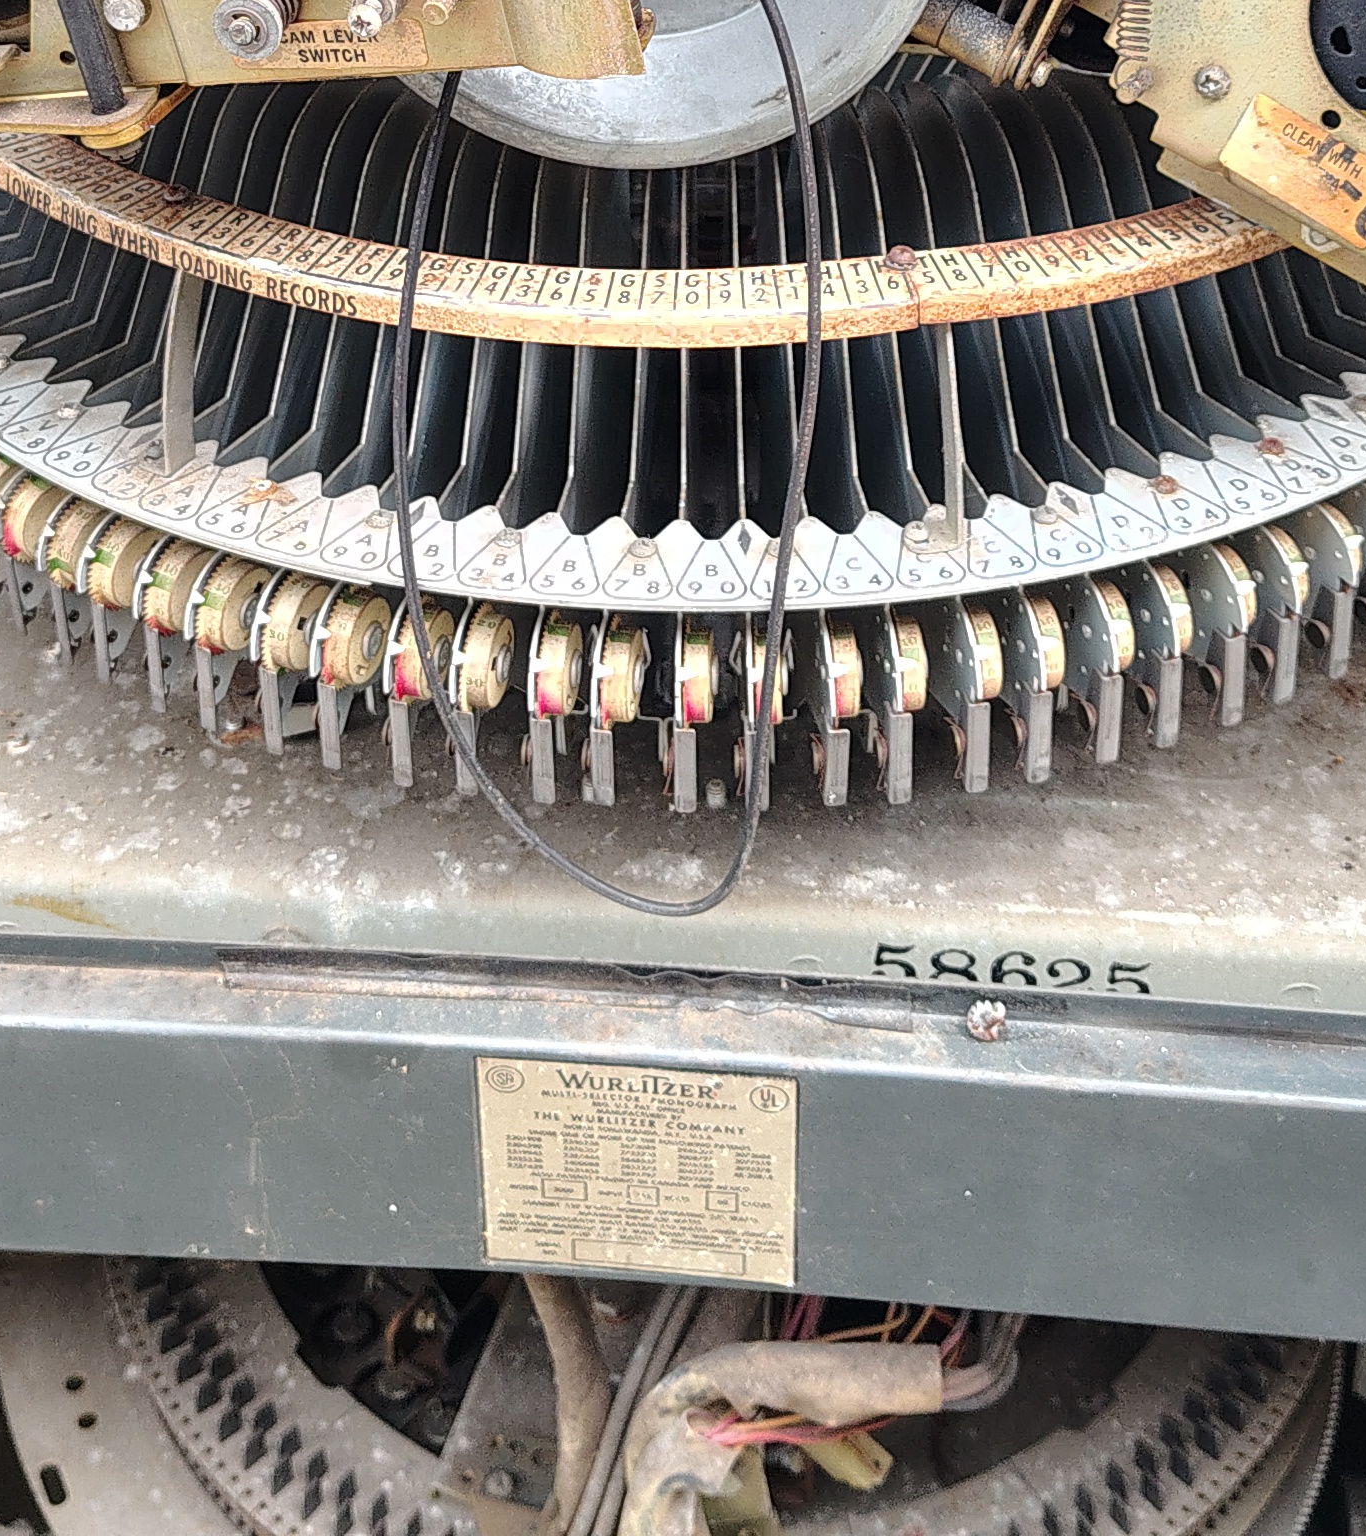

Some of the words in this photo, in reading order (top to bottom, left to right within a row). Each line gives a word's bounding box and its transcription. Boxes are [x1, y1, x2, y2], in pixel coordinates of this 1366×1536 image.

[298, 49, 366, 62] SWITCH
[1282, 123, 1326, 154] CLEAN
[1328, 149, 1363, 179] WITH
[6, 174, 52, 215] LOWER
[61, 201, 98, 236] RING
[109, 221, 160, 261] WHEN
[171, 246, 252, 291] LOADING
[266, 276, 358, 316] RECORDS
[232, 212, 249, 225] R
[338, 242, 356, 255] R
[492, 266, 507, 278] G
[524, 269, 536, 280] S
[555, 271, 571, 284] G
[620, 274, 635, 287] G
[655, 274, 665, 287] S
[685, 274, 700, 287] G
[719, 274, 730, 286] S
[751, 273, 765, 285] H
[786, 270, 796, 283] T
[850, 264, 861, 276] T
[940, 254, 958, 266] H
[213, 228, 230, 239] 3
[240, 236, 255, 246] 6
[268, 243, 286, 254] 5
[297, 250, 314, 262] 8
[389, 269, 404, 281] 9
[486, 281, 497, 294] 4
[515, 285, 530, 297] 3
[551, 288, 562, 300] 6
[618, 291, 630, 303] 8
[652, 291, 664, 304] 7
[720, 290, 731, 303] 9
[755, 289, 766, 301] 2
[824, 284, 835, 296] 4
[858, 281, 869, 293] 3
[888, 276, 899, 290] 6
[923, 272, 935, 283] 5
[953, 269, 968, 281] 8
[982, 265, 993, 277] 7
[1046, 255, 1059, 267] 9
[1164, 229, 1182, 240] 3
[1192, 222, 1209, 233] 6
[562, 560, 576, 572] B
[705, 565, 719, 577] B
[646, 581, 660, 594] 8
[688, 582, 703, 595] 9
[908, 569, 922, 582] 5
[939, 567, 953, 579] 6
[871, 942, 1151, 995] 58625
[556, 1068, 714, 1100] WURLITZER
[651, 1098, 737, 1110] PHONOGRAPH
[533, 1111, 560, 1121] THE
[571, 1114, 656, 1128] WURLITZER
[666, 1121, 746, 1135] COMPANY
